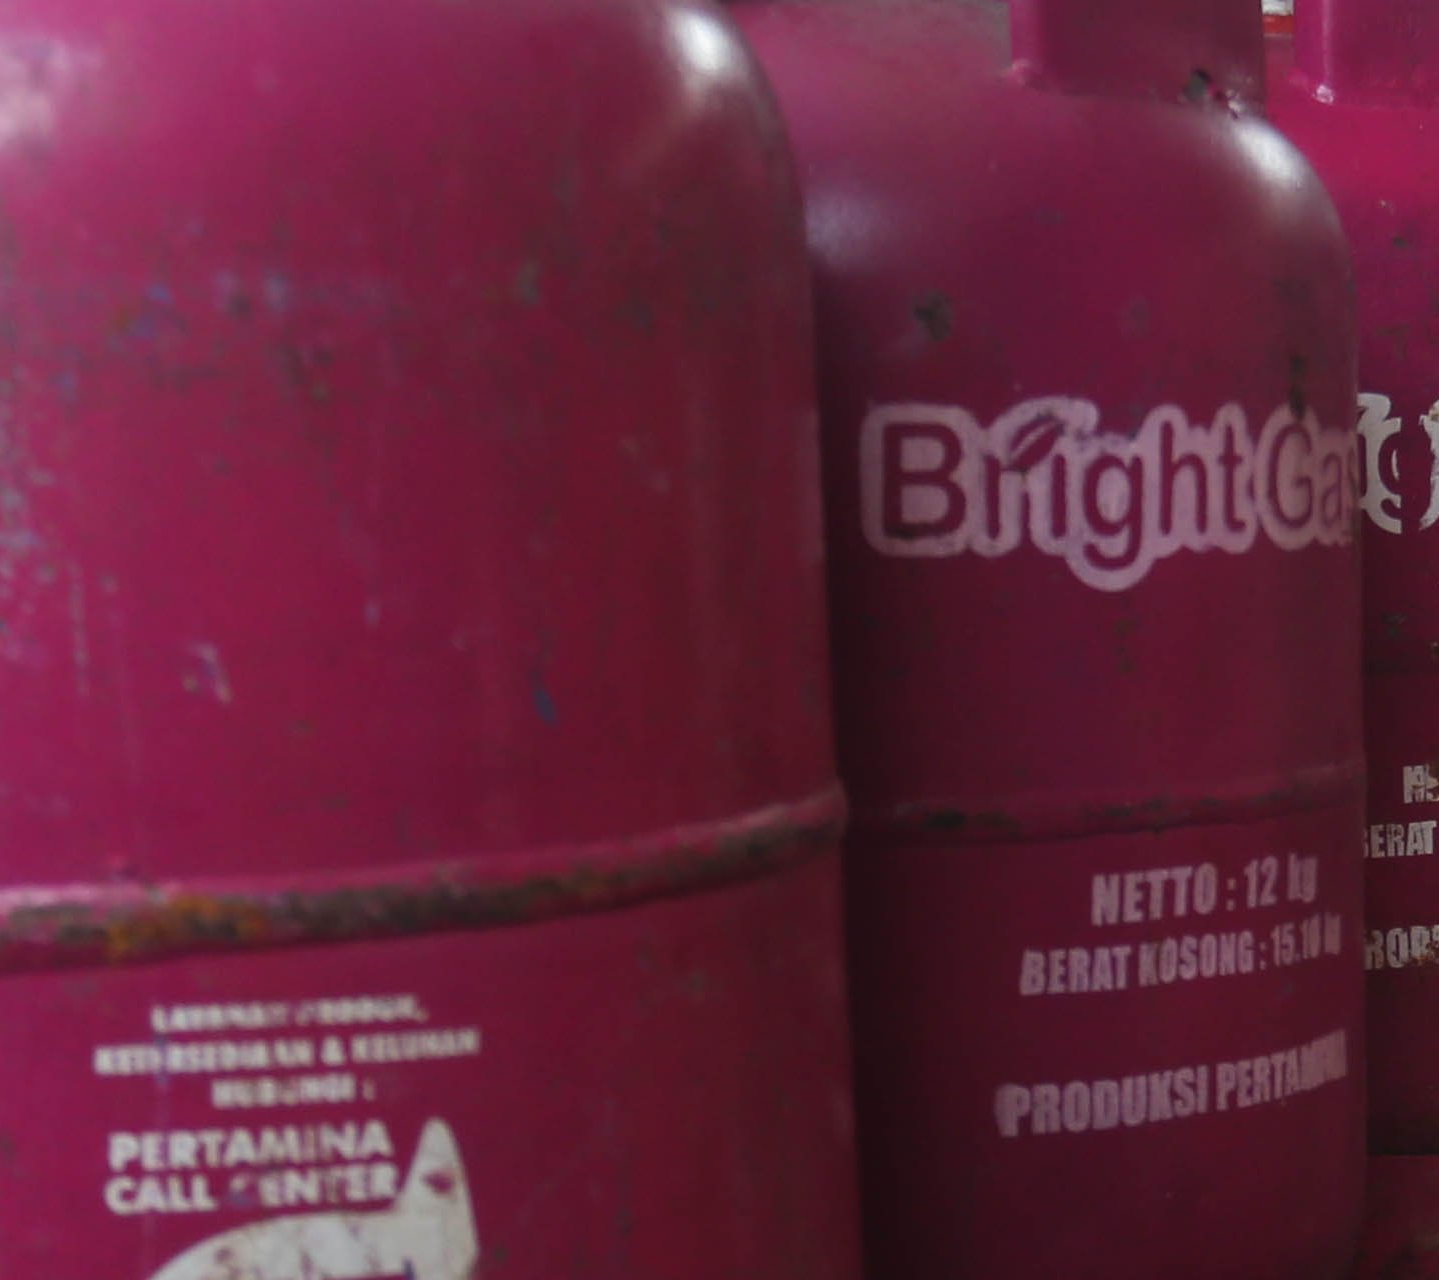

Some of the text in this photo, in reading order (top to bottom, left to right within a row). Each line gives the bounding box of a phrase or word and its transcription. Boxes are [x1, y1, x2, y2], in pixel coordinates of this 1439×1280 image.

[1091, 861, 1218, 927] NETTO
[1244, 855, 1279, 909] 12
[1019, 944, 1133, 996] BERAT
[1138, 930, 1255, 987] KOSONG
[995, 1065, 1210, 1138] PRODUKSI
[107, 1118, 395, 1173] PERTAMINA
[104, 1173, 218, 1216] CALL
